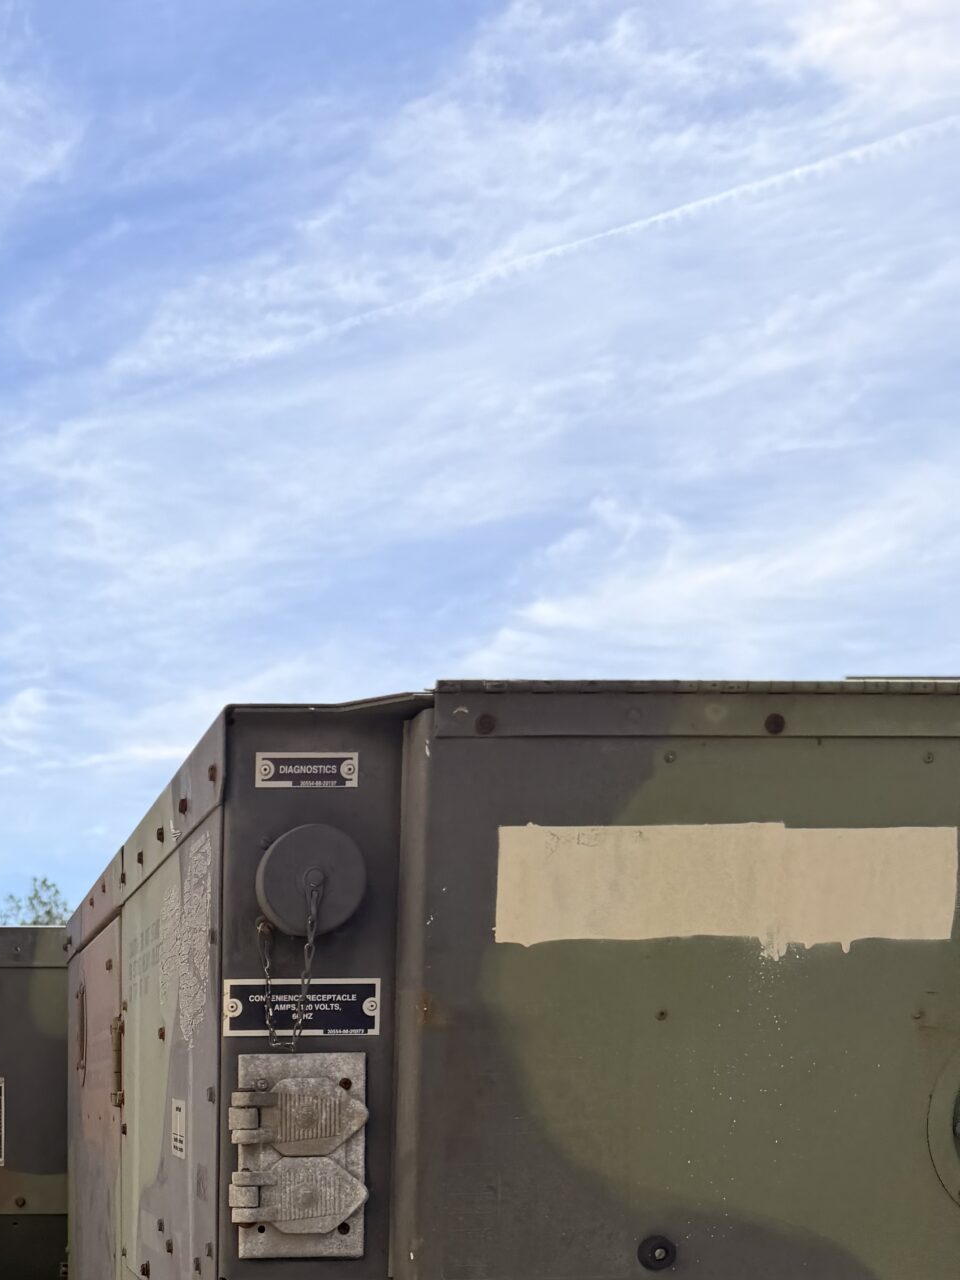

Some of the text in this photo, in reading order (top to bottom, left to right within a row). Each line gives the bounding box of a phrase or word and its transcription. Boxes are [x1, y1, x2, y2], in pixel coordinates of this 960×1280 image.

[279, 765, 338, 774] DIAGNOSTICS
[248, 994, 357, 1002] CONENIENC RECEPTACLE
[314, 1003, 342, 1011] VOLTS,
